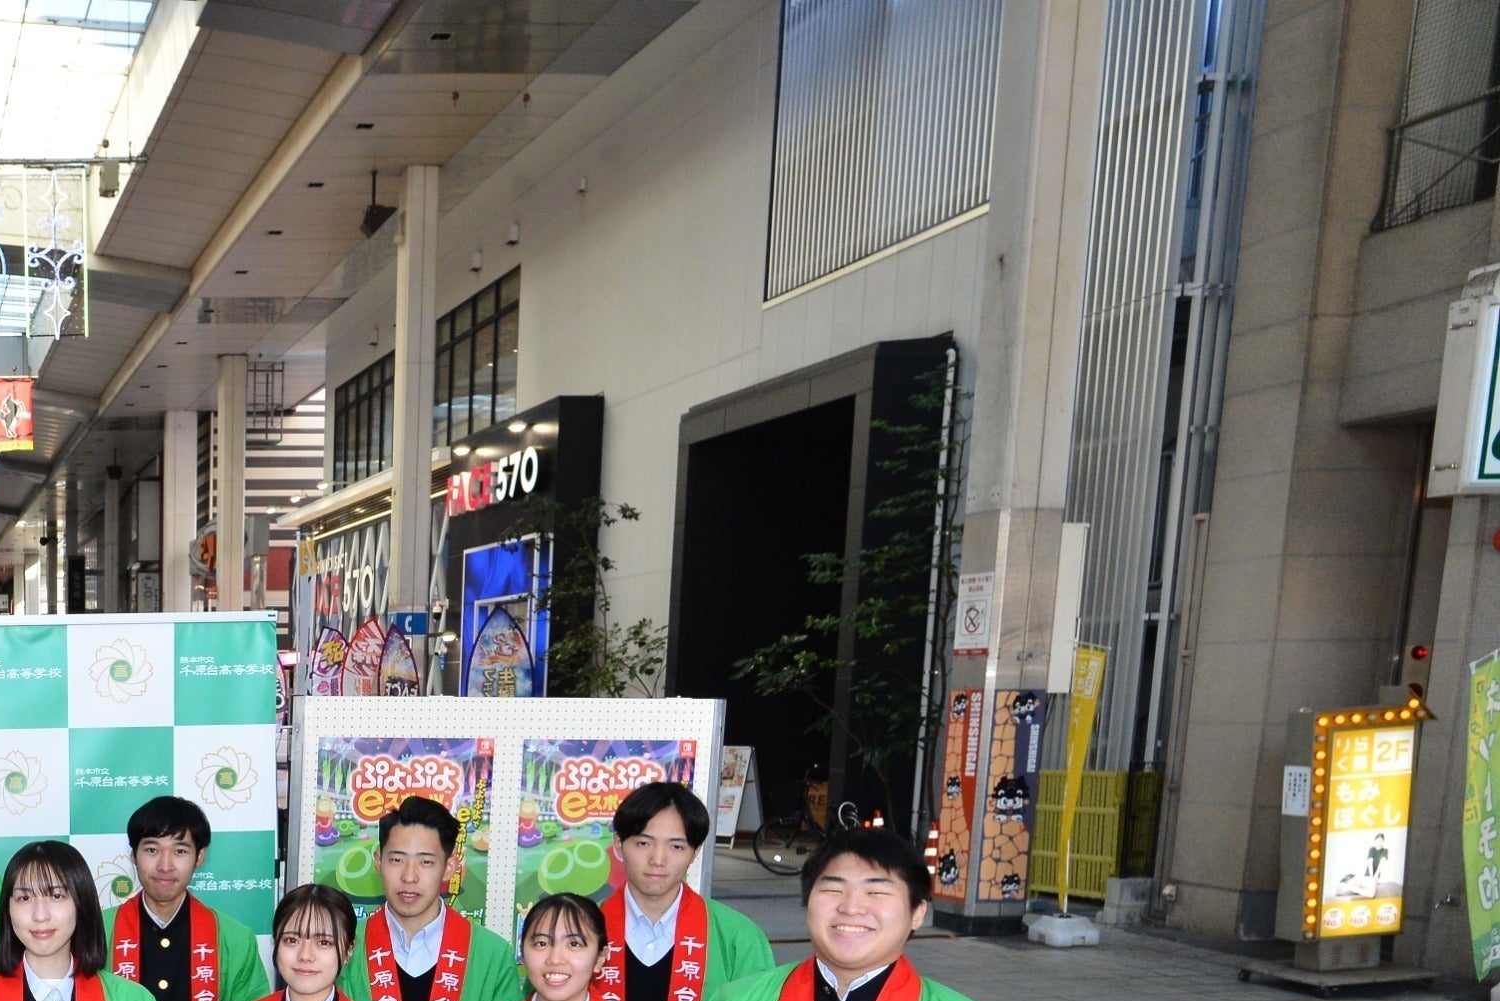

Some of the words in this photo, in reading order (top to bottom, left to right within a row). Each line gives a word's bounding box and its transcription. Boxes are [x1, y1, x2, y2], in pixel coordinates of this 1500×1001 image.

[496, 446, 538, 501] 570
[343, 564, 374, 613] 570
[965, 691, 982, 777] SHINSHIGAI
[1026, 723, 1040, 773] SHINSHIGAI
[1377, 739, 1410, 763] 2F
[355, 760, 456, 791] ぷよぷよ
[1336, 779, 1381, 804] もみ
[1334, 802, 1402, 829] ほぐし
